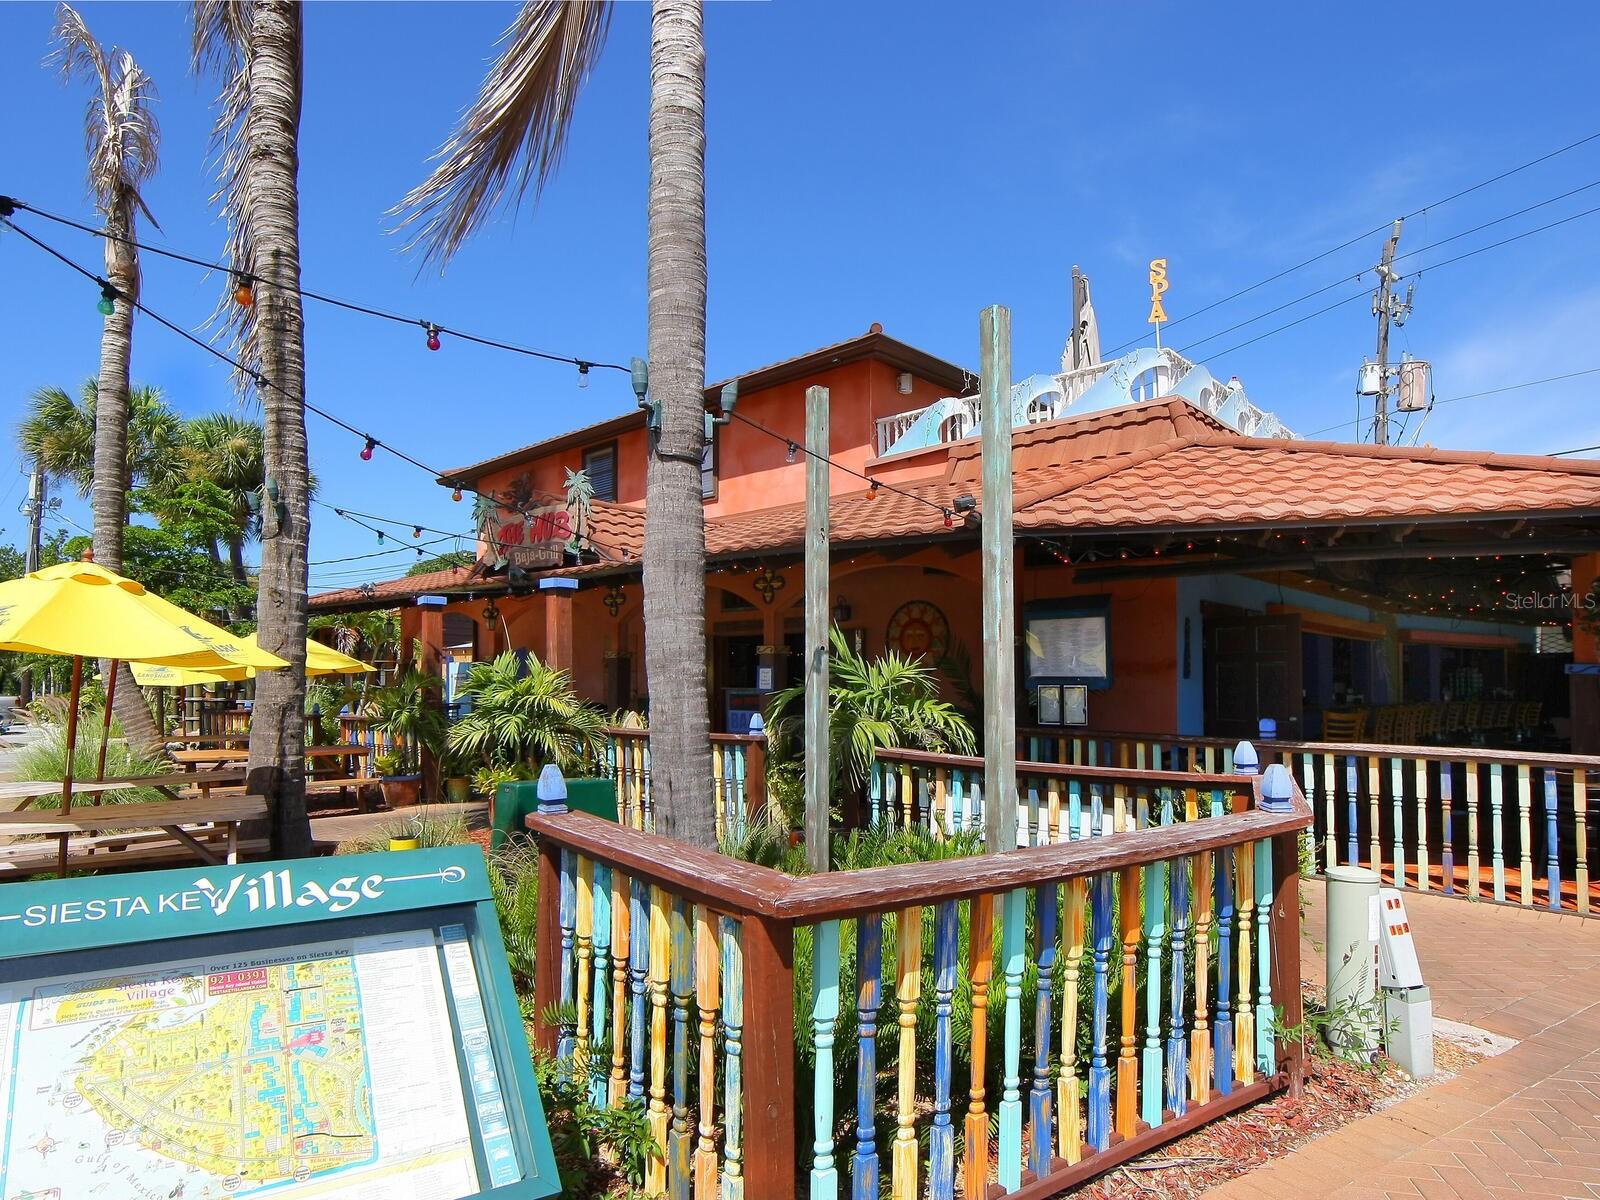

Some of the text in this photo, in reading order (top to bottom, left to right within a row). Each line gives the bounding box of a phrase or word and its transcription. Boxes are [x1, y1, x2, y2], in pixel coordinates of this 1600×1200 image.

[1148, 259, 1169, 322] SPA
[497, 511, 572, 556] THE HUB
[23, 869, 385, 927] SIESTA KEY Village
[250, 956, 295, 967] Businesses
[309, 951, 333, 959] Siesta
[335, 948, 349, 956] Key
[115, 977, 157, 992] Siesta
[127, 987, 175, 1002] Village
[74, 1153, 111, 1168] Gulf
[113, 1162, 130, 1175] of
